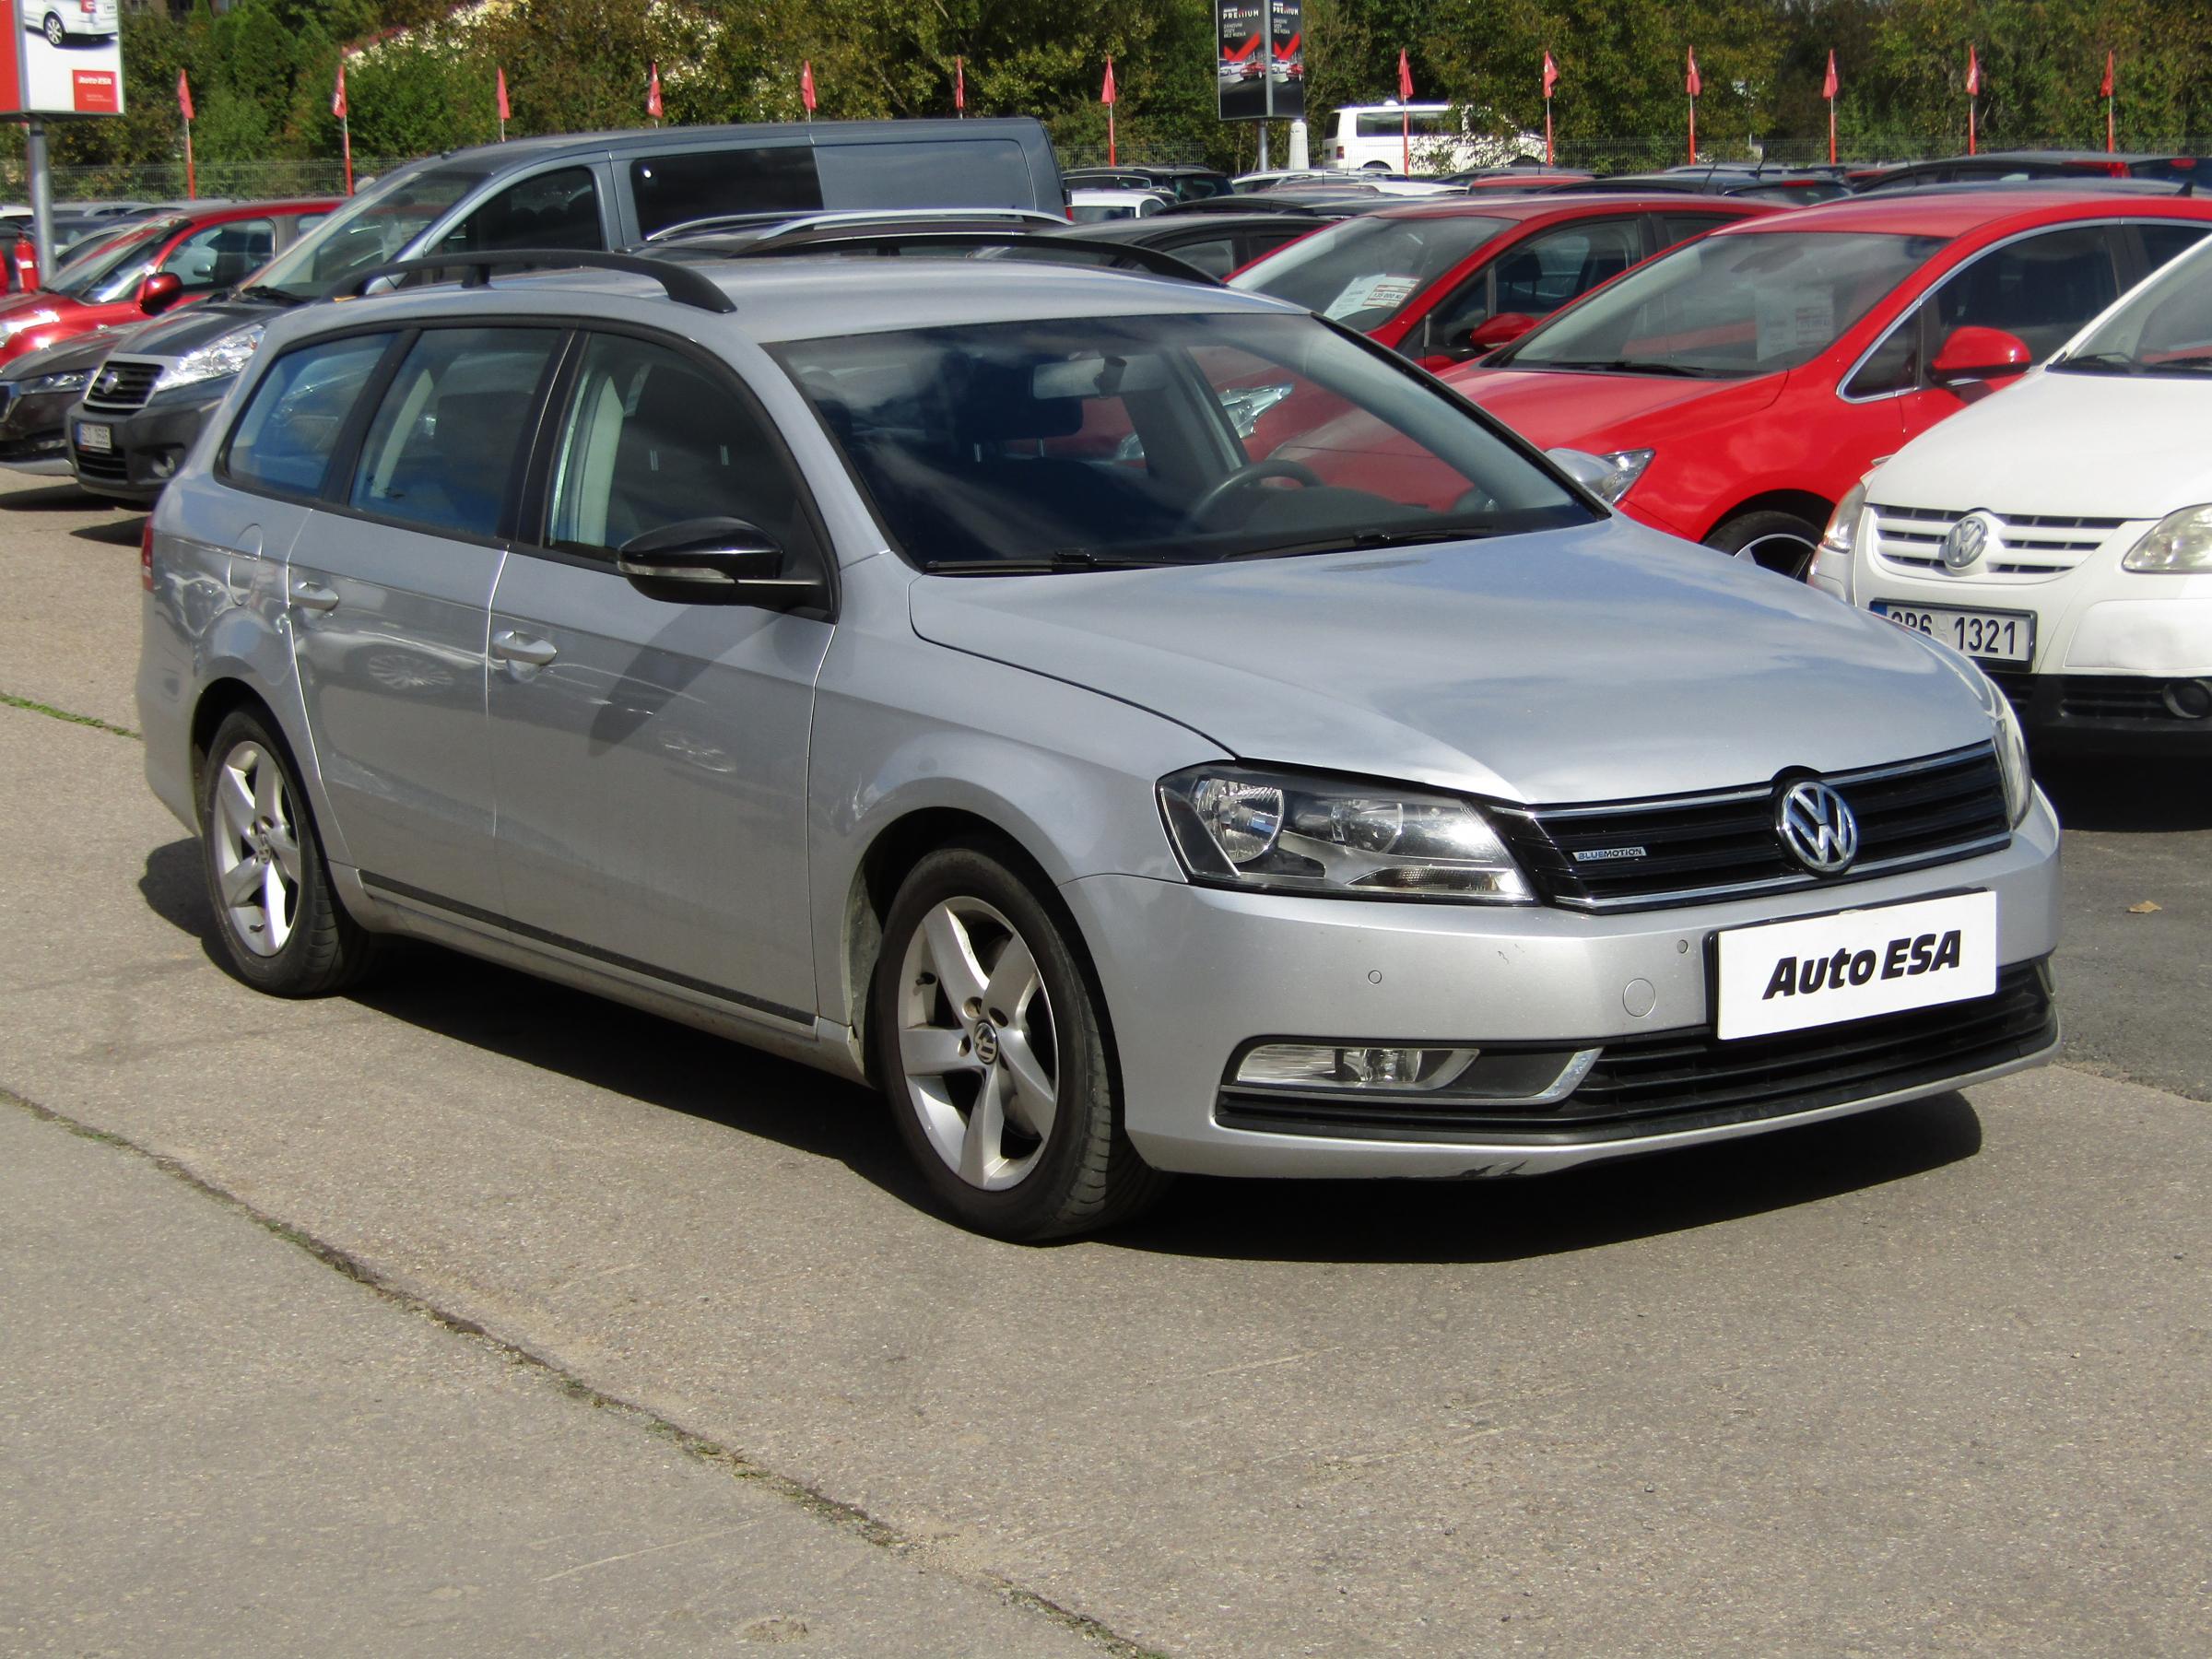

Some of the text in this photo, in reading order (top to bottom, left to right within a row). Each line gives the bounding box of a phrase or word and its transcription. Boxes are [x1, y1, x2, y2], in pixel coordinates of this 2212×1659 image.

[1954, 617, 2015, 654] 1321
[1578, 848, 1642, 860] BLUEMOTION
[1782, 781, 1858, 873] VW
[1762, 929, 1961, 1000] Auto ESA
